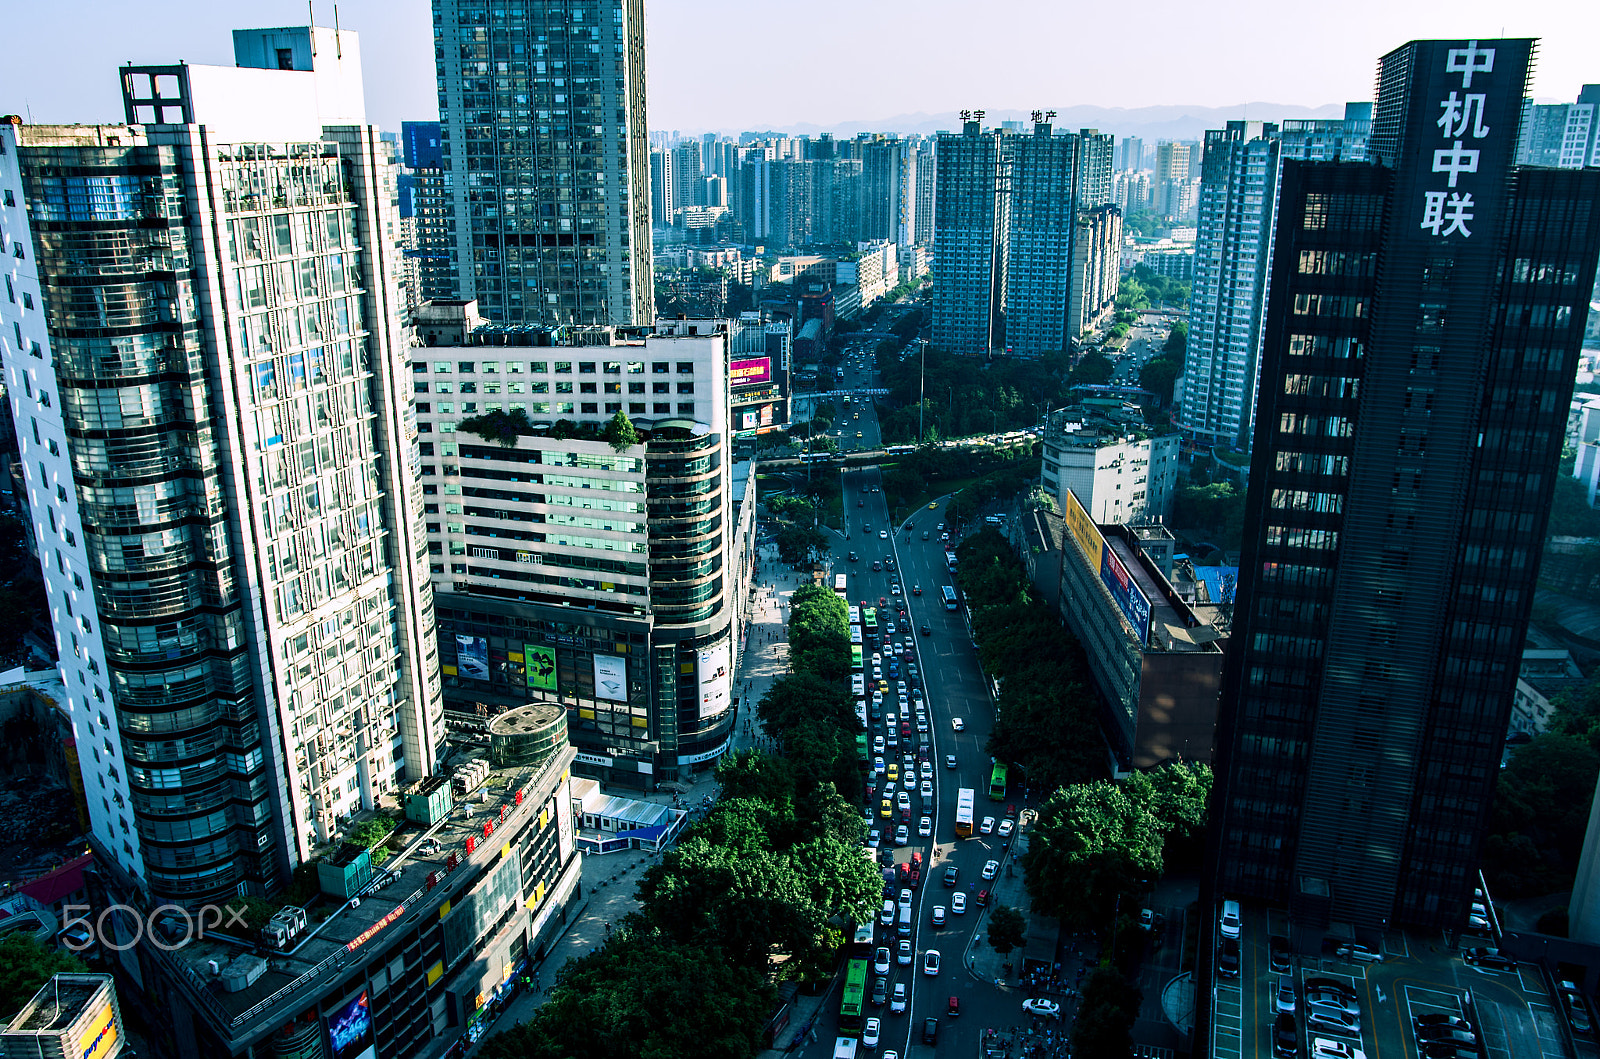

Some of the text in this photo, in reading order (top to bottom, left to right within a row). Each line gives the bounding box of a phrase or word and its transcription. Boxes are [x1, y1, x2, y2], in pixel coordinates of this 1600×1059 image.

[959, 109, 1057, 123] 华宇 地产
[1420, 40, 1496, 238] 中机中联
